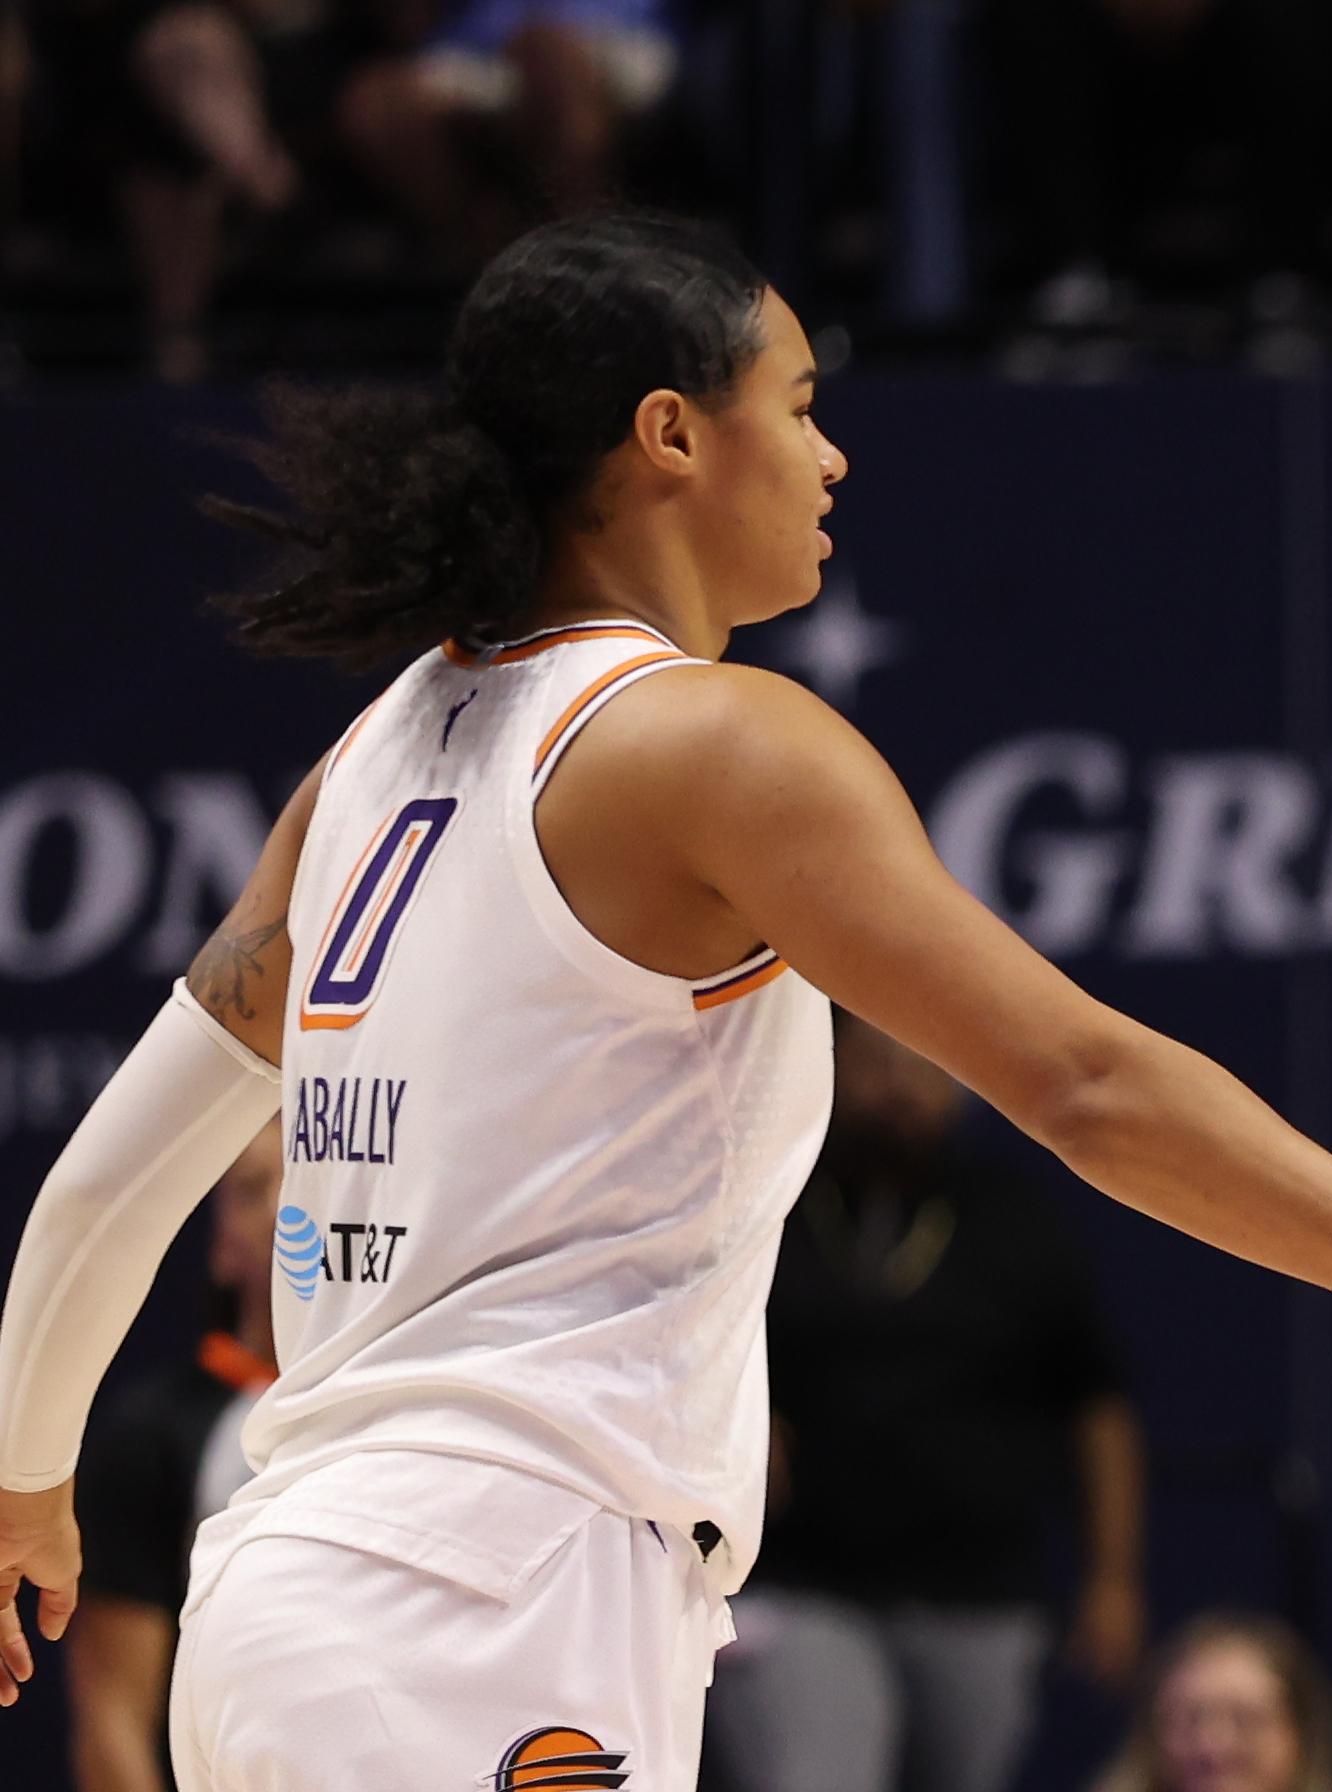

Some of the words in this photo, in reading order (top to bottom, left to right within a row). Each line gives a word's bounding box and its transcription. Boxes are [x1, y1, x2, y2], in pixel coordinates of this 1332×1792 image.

[301, 797, 458, 1031] 0
[290, 1077, 407, 1165] ABALLY
[320, 1222, 408, 1284] AT&T
